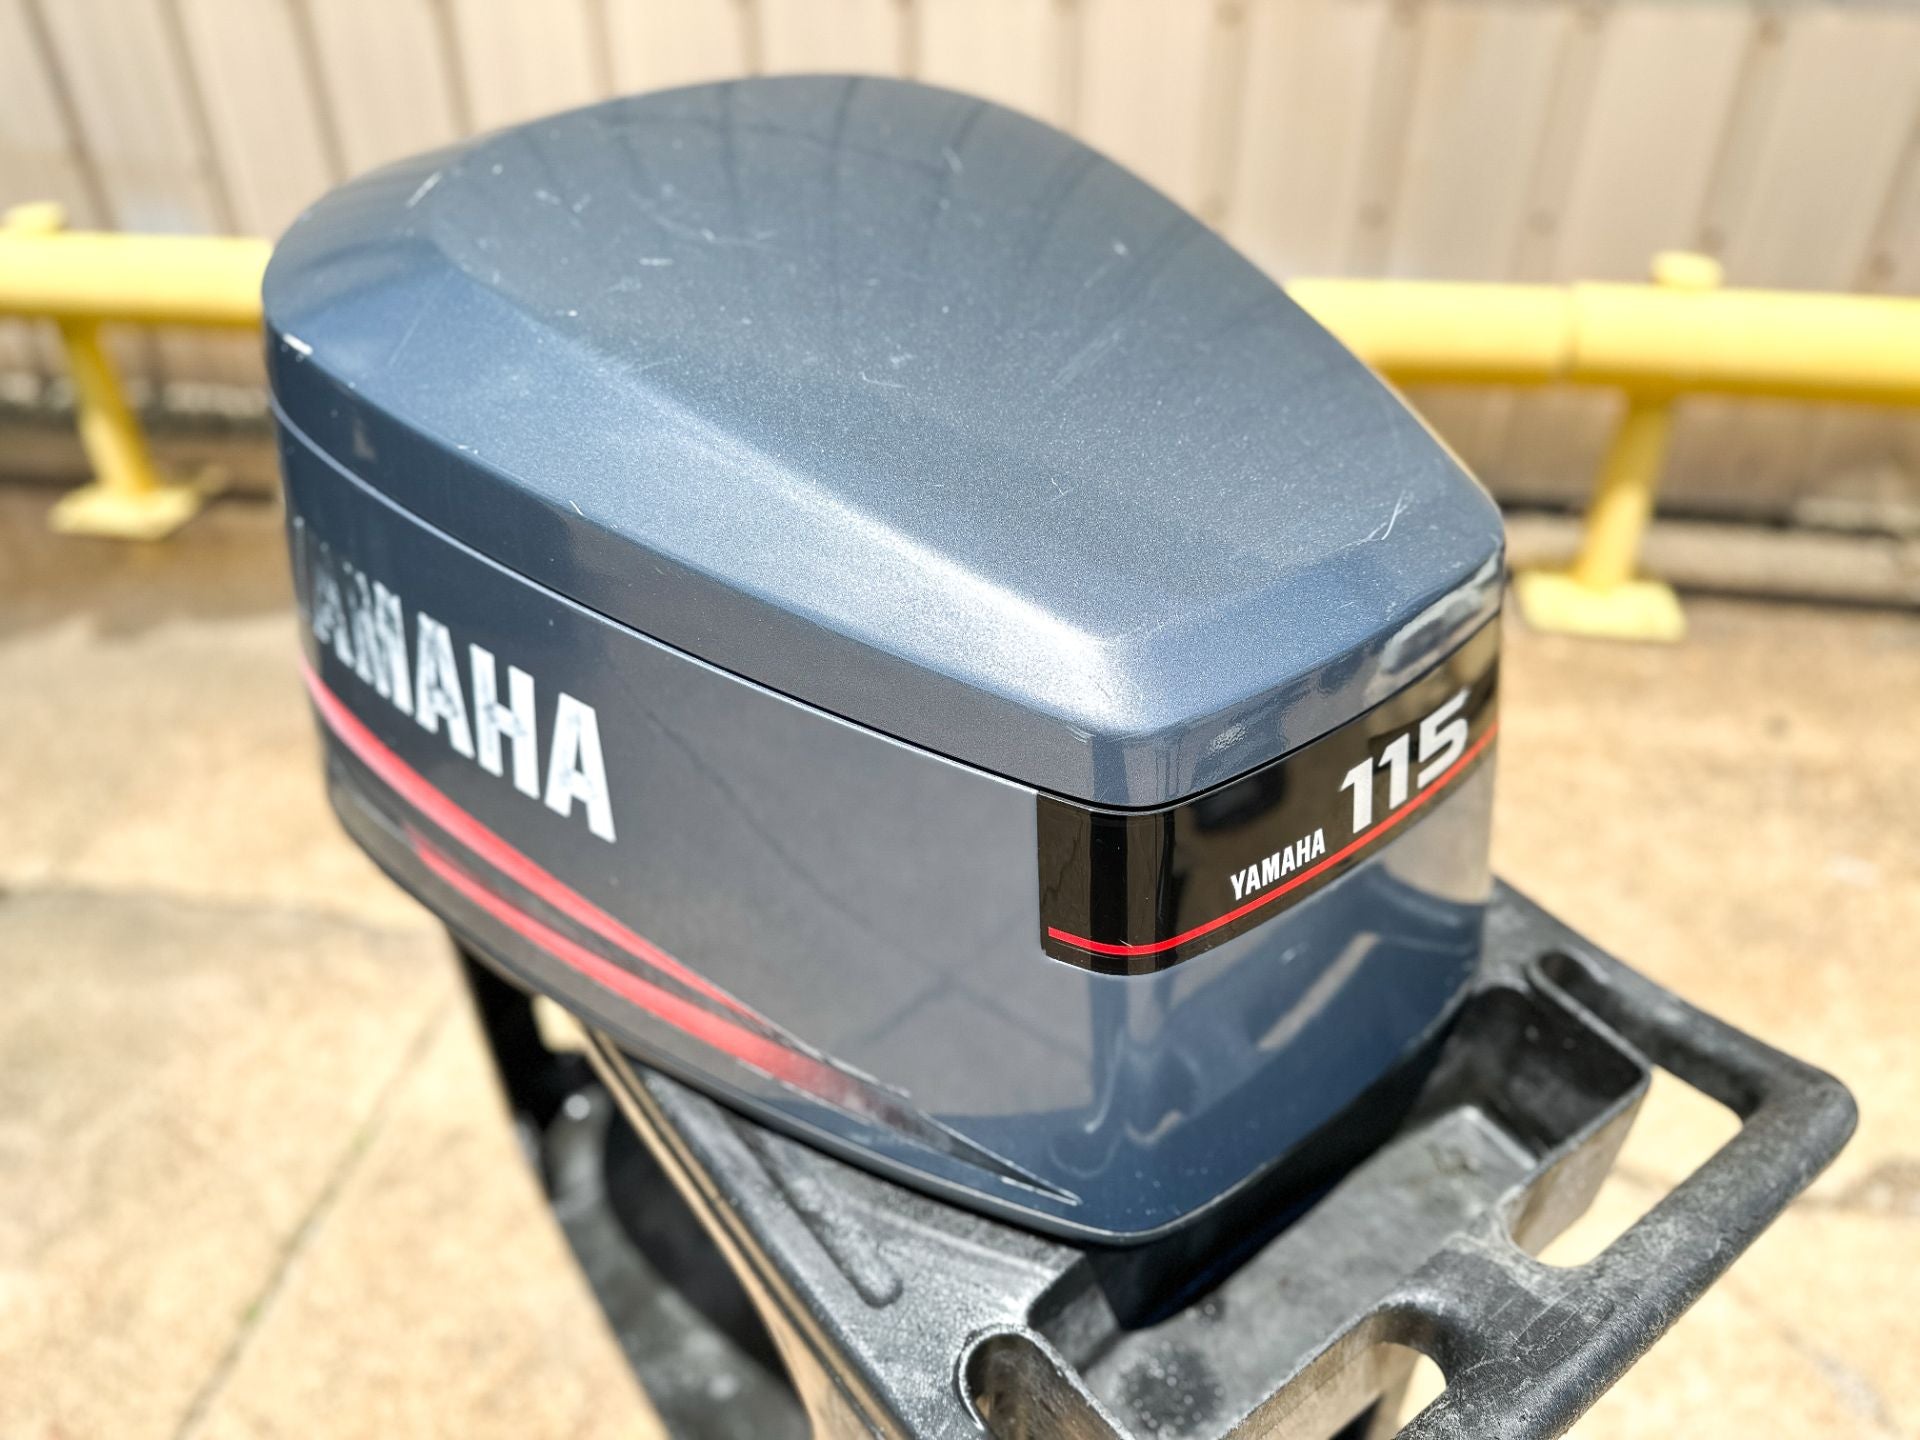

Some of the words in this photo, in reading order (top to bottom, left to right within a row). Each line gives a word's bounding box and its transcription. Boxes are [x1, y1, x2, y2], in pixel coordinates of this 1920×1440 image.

[294, 514, 616, 843] AMAHA
[1230, 828, 1326, 901] YAMAHA
[1339, 688, 1470, 834] 115
